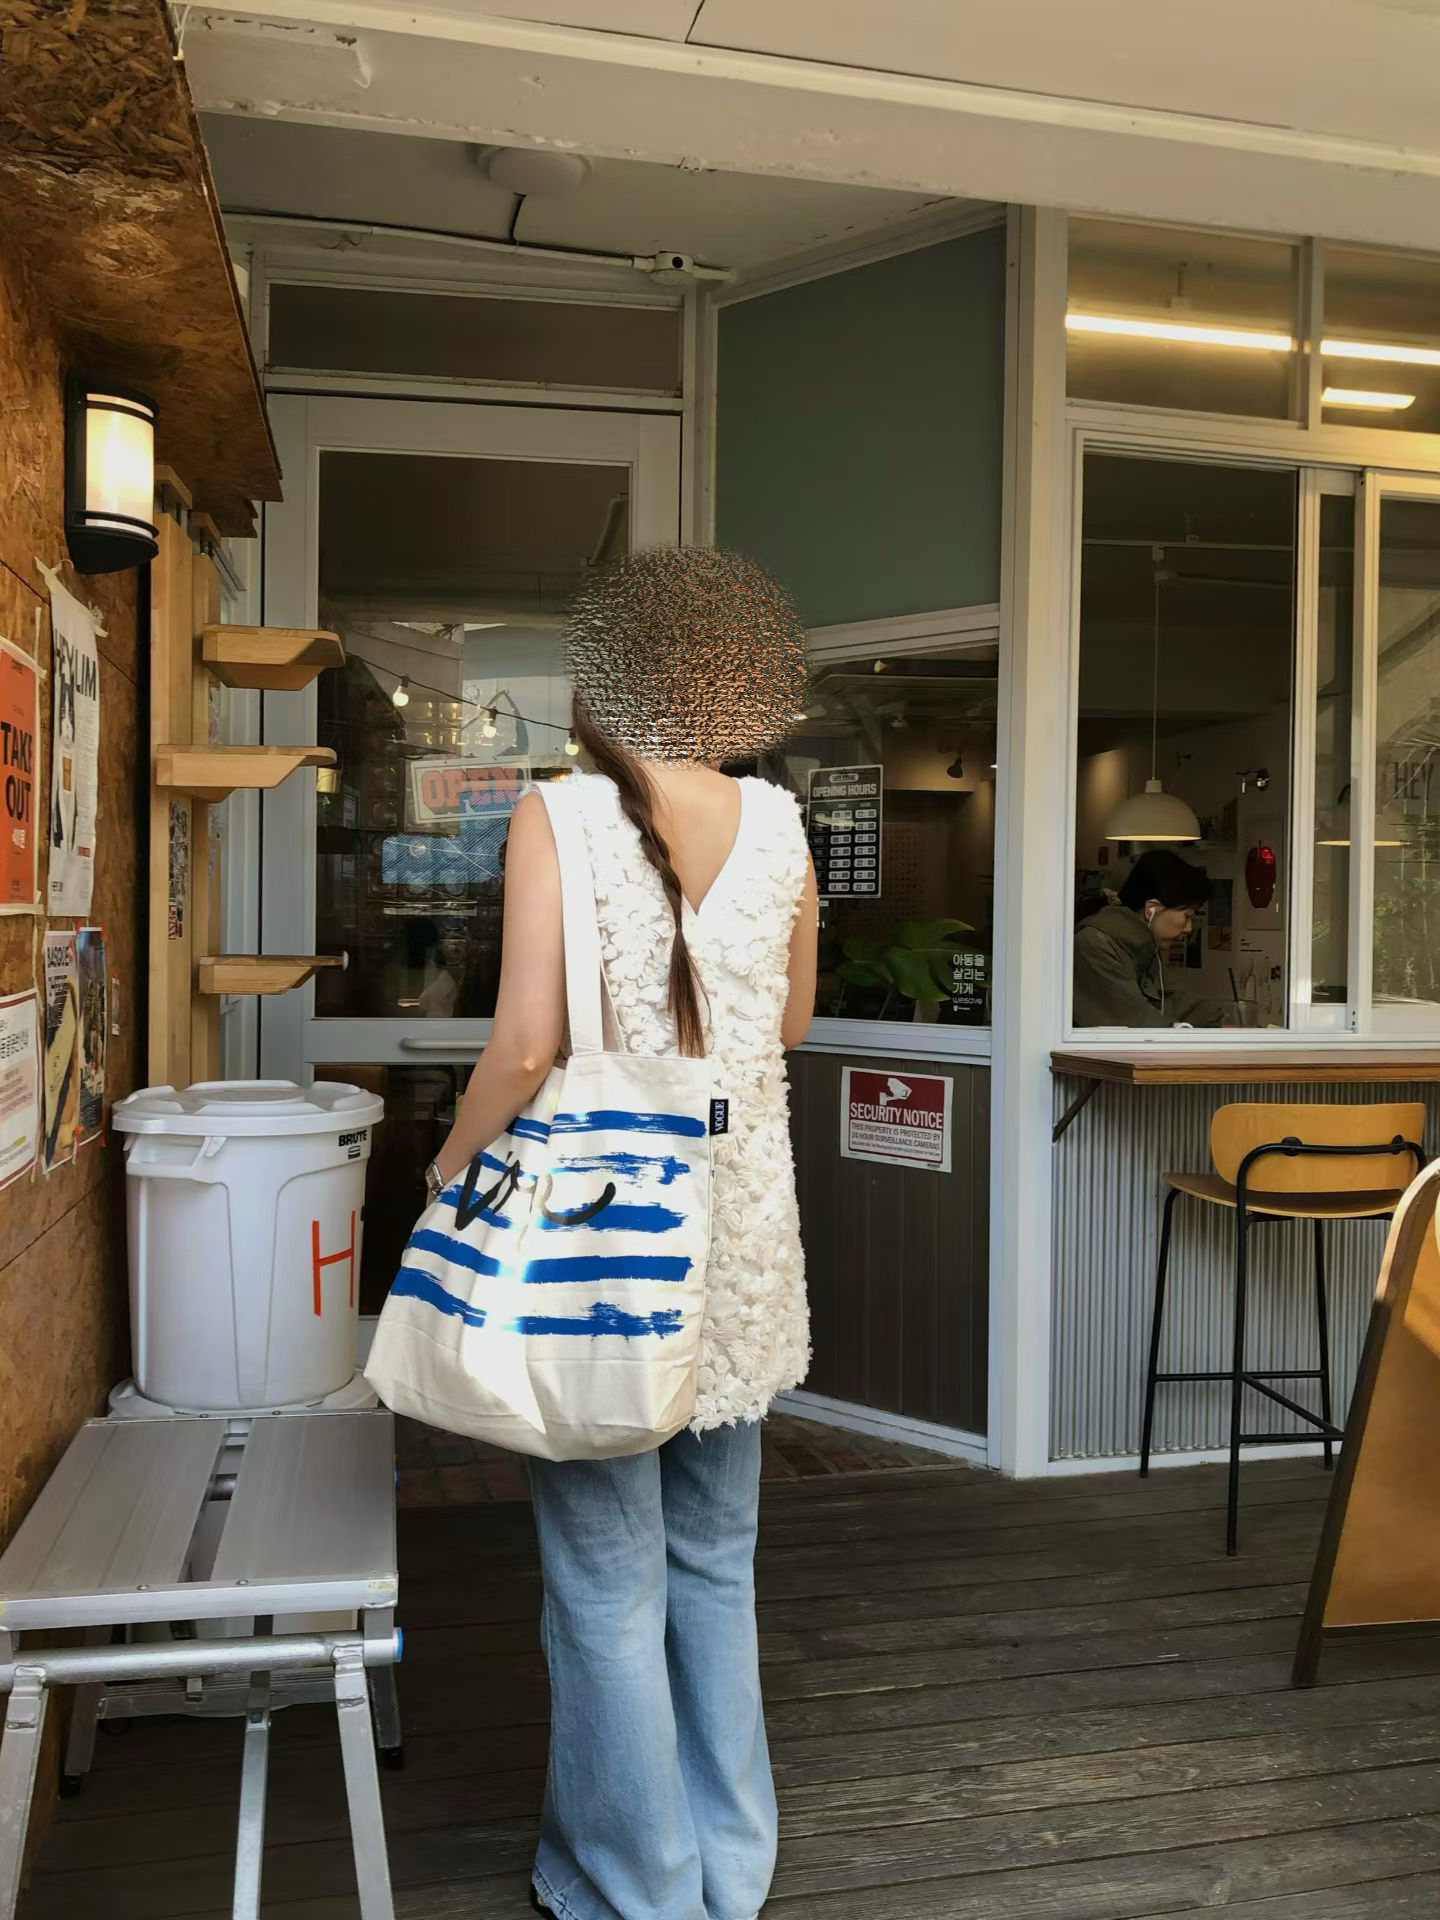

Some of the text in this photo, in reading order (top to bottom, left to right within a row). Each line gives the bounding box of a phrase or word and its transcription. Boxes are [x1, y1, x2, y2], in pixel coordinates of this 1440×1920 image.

[1, 721, 33, 774] TAKE
[422, 766, 518, 811] OPEN
[812, 784, 877, 798] OPENING HOURS
[5, 774, 32, 823] OUT
[953, 954, 985, 966] 아동을
[953, 968, 985, 981] 살리는
[952, 982, 974, 995] 가게
[714, 1101, 725, 1132] VOGUE
[850, 1102, 943, 1129] SECURITY NOTICE
[338, 1129, 368, 1147] BRUTE
[851, 1122, 941, 1141] THIS PROPERTY IS PROTECTED BY
[851, 1131, 859, 1139] 24
[859, 1132, 875, 1141] HOUR
[875, 1134, 913, 1147] SURVEILLANCE
[913, 1140, 941, 1150] CAMERAS
[312, 1210, 356, 1316] H
